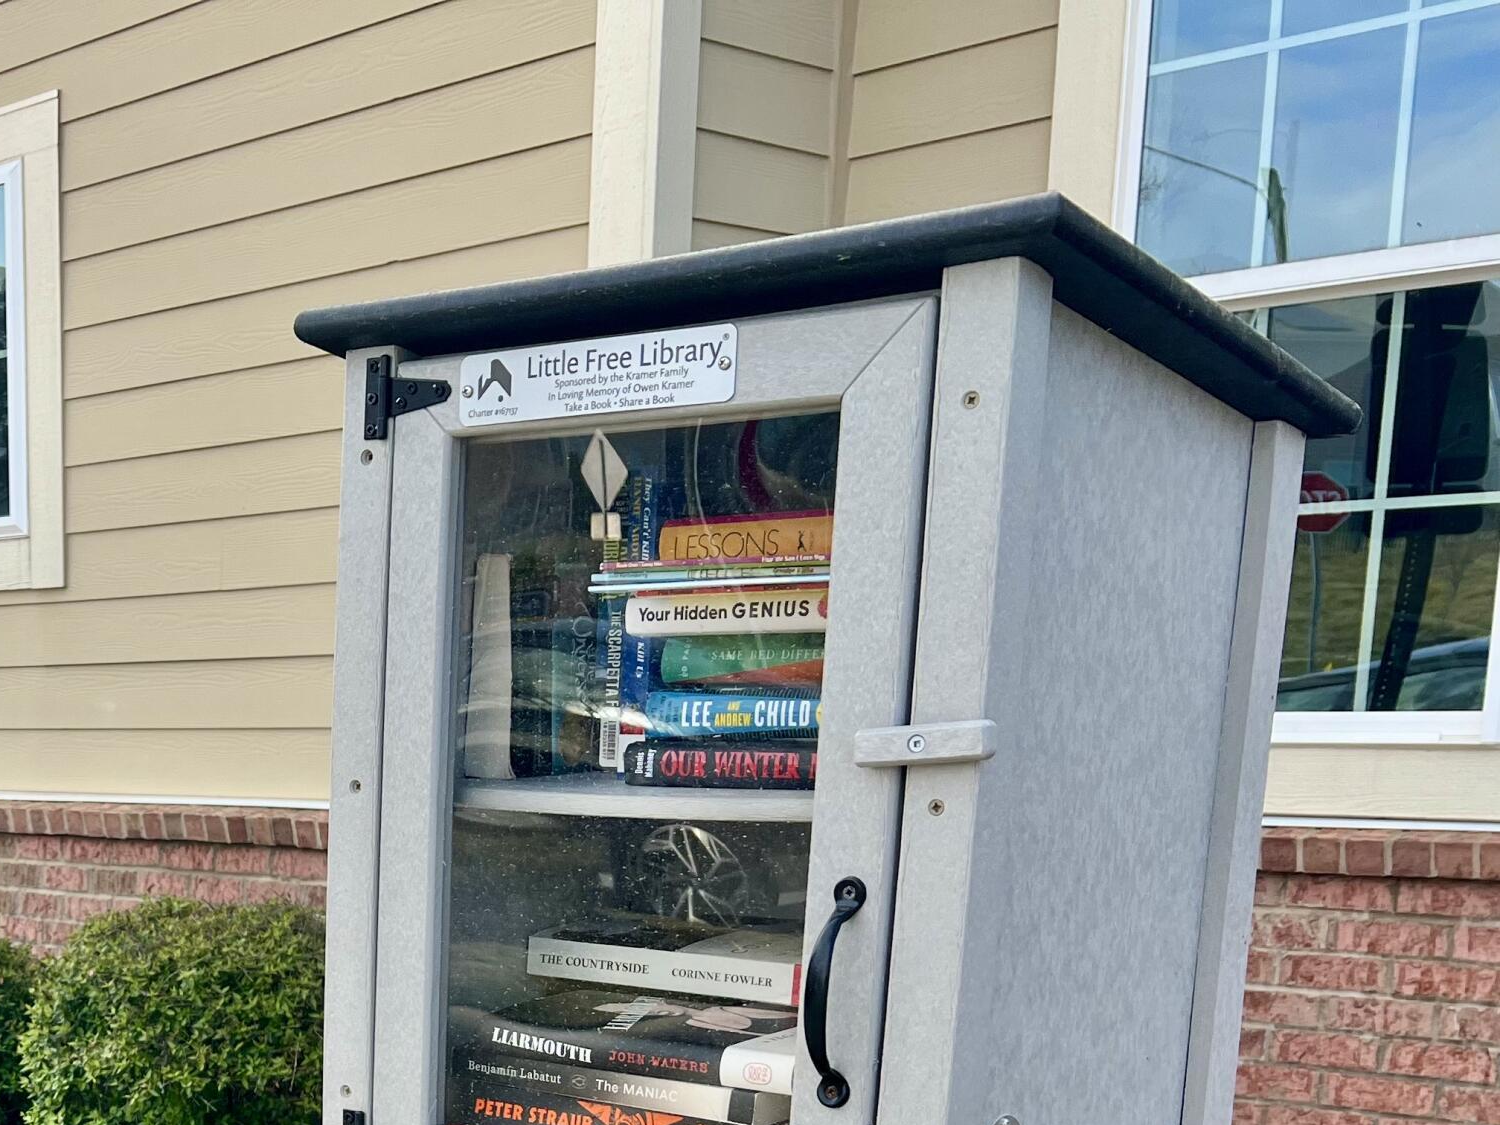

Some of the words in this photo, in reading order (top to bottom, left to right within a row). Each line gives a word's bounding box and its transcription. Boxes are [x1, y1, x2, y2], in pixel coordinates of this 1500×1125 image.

[527, 349, 579, 379] Little
[585, 348, 632, 373] Free
[639, 338, 723, 368] Library
[555, 374, 597, 389] Sponsored
[598, 372, 608, 386] by
[610, 371, 624, 383] the
[626, 369, 658, 381] Kramer
[660, 366, 690, 379] Family
[548, 391, 556, 401] In
[557, 387, 584, 403] Loving
[585, 385, 621, 399] Memory
[622, 383, 632, 395] of
[633, 382, 660, 394] Owen
[661, 379, 695, 391] Kramer
[468, 408, 493, 418] Charter
[564, 402, 582, 412] Take
[584, 403, 589, 411] a
[591, 398, 612, 410] Book
[619, 396, 643, 408] Share
[645, 396, 650, 405] a
[652, 394, 675, 405] Book
[674, 529, 780, 560] LESSONS
[611, 610, 622, 627] THE
[639, 607, 670, 622] Your
[674, 605, 727, 620] Hidden
[732, 599, 810, 619] GENIUS
[605, 627, 622, 697] SCARPETTA
[710, 649, 743, 660] SAME
[635, 666, 644, 678] Us
[681, 701, 713, 727] LEE
[727, 700, 740, 711] AND
[755, 700, 810, 727] CHILD
[714, 713, 751, 727] ANDREW
[635, 752, 644, 774] Dennis
[660, 750, 707, 777] OUR
[714, 751, 800, 780] WINTER
[540, 954, 563, 966] THE
[565, 956, 650, 975] COUNTRYSIDE
[671, 968, 721, 982] CORINNE
[724, 973, 773, 987] FOWLER
[491, 1027, 592, 1063] LIARMOUTH
[608, 1050, 648, 1066] JOHN
[650, 1055, 709, 1073] WATERS
[519, 1066, 562, 1085] Labatut
[595, 1079, 620, 1094] The
[622, 1082, 678, 1101] MANIAC
[474, 1097, 524, 1121] PETER
